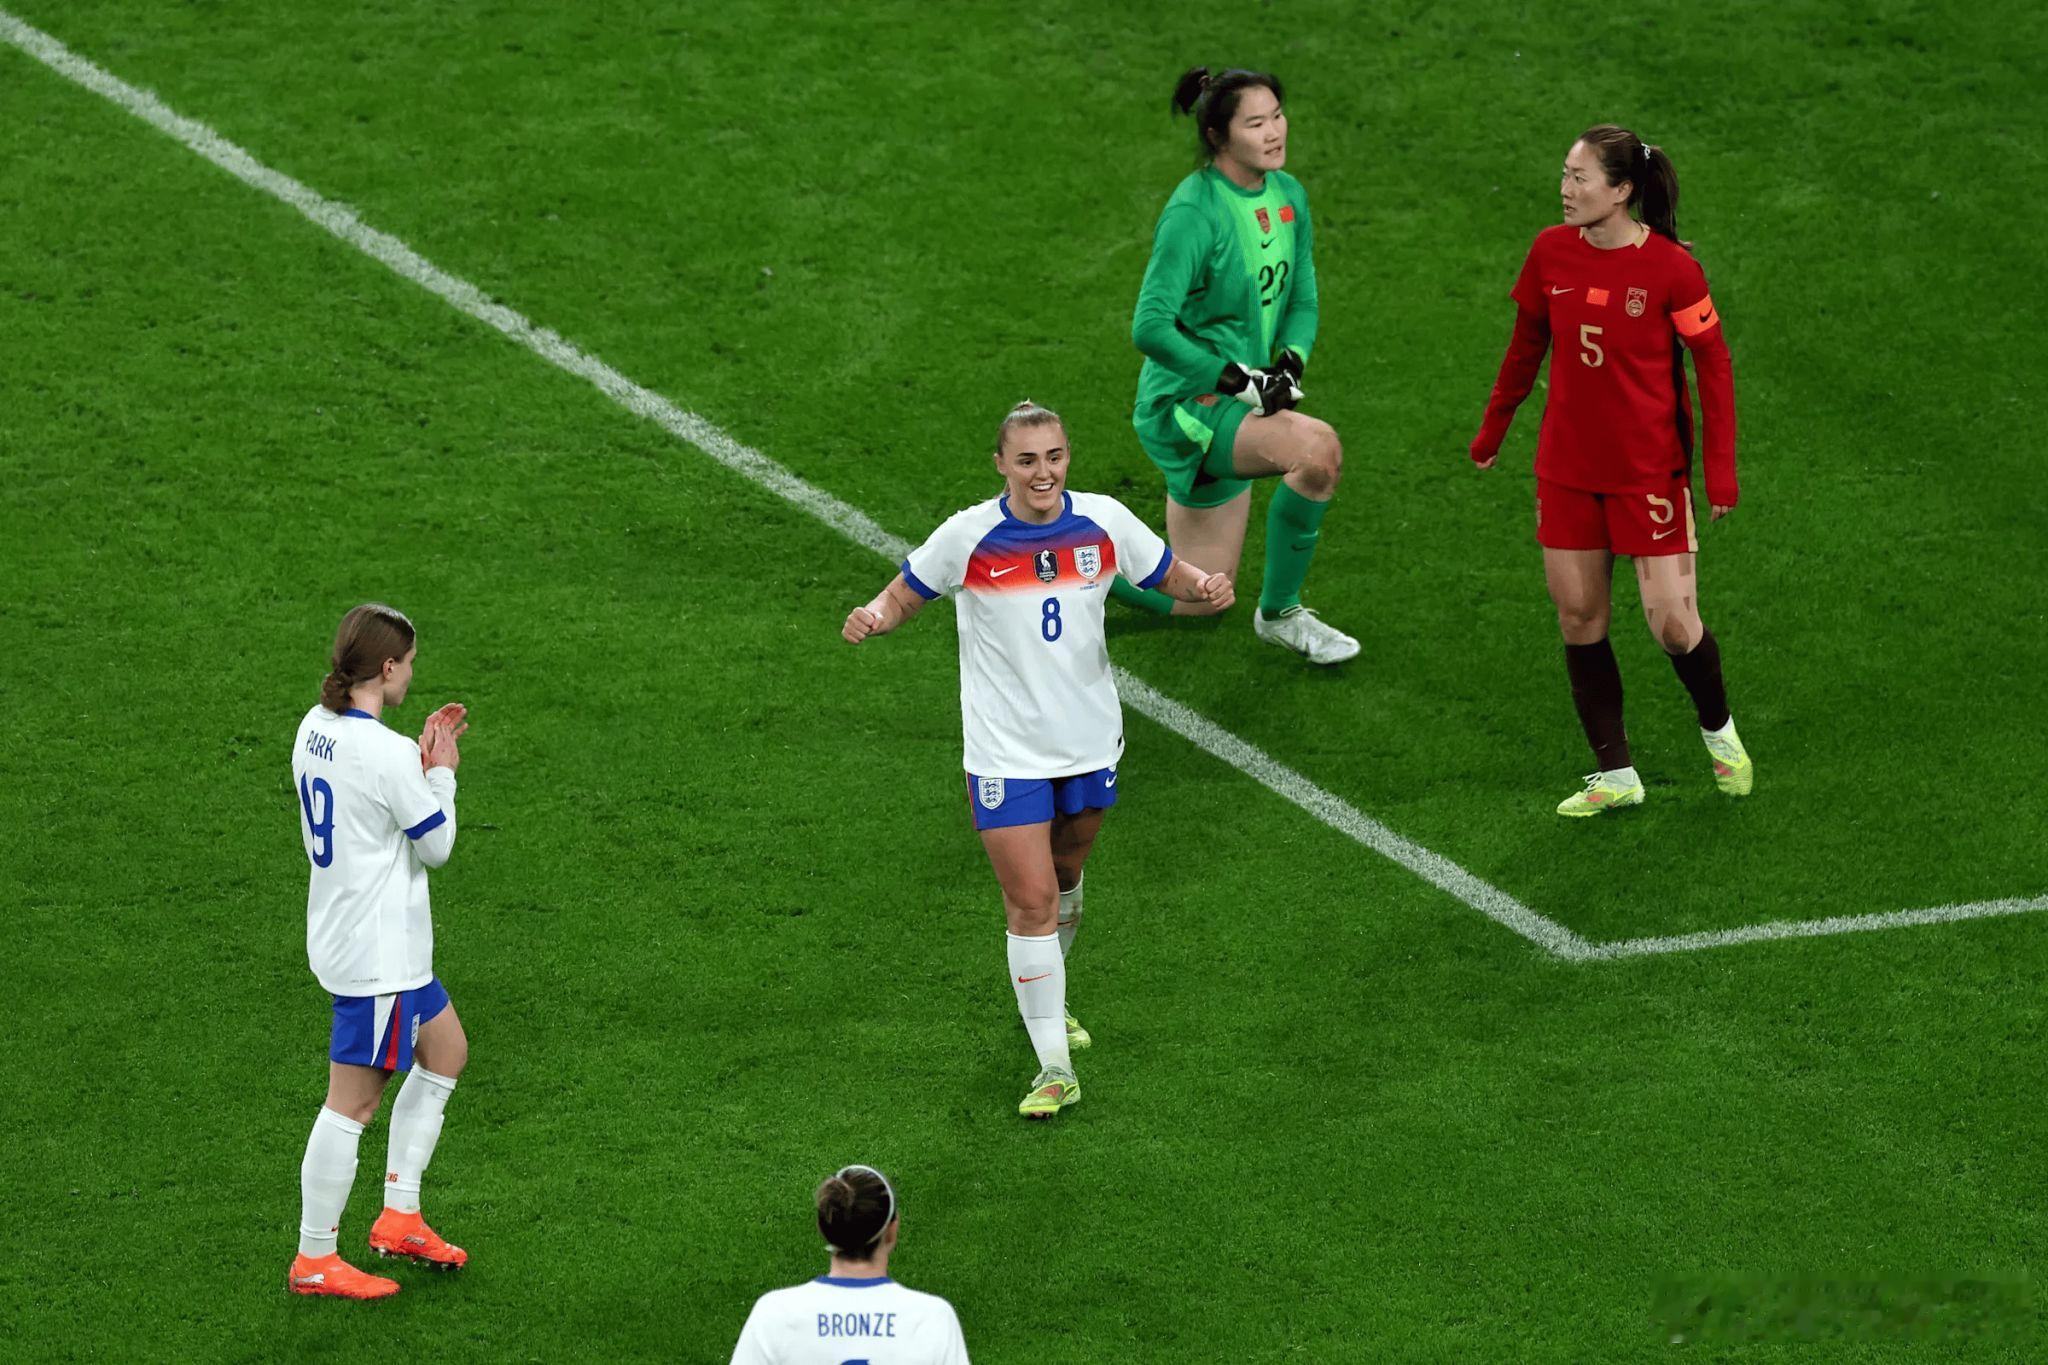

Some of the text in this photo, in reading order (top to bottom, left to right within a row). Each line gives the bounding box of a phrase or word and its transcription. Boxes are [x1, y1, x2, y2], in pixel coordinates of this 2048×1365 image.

[1258, 260, 1288, 307] 23
[1580, 324, 1604, 368] 5
[1042, 597, 1062, 642] 8
[305, 730, 337, 762] PARK
[301, 770, 335, 868] 19
[817, 1312, 897, 1337] BRONZE
